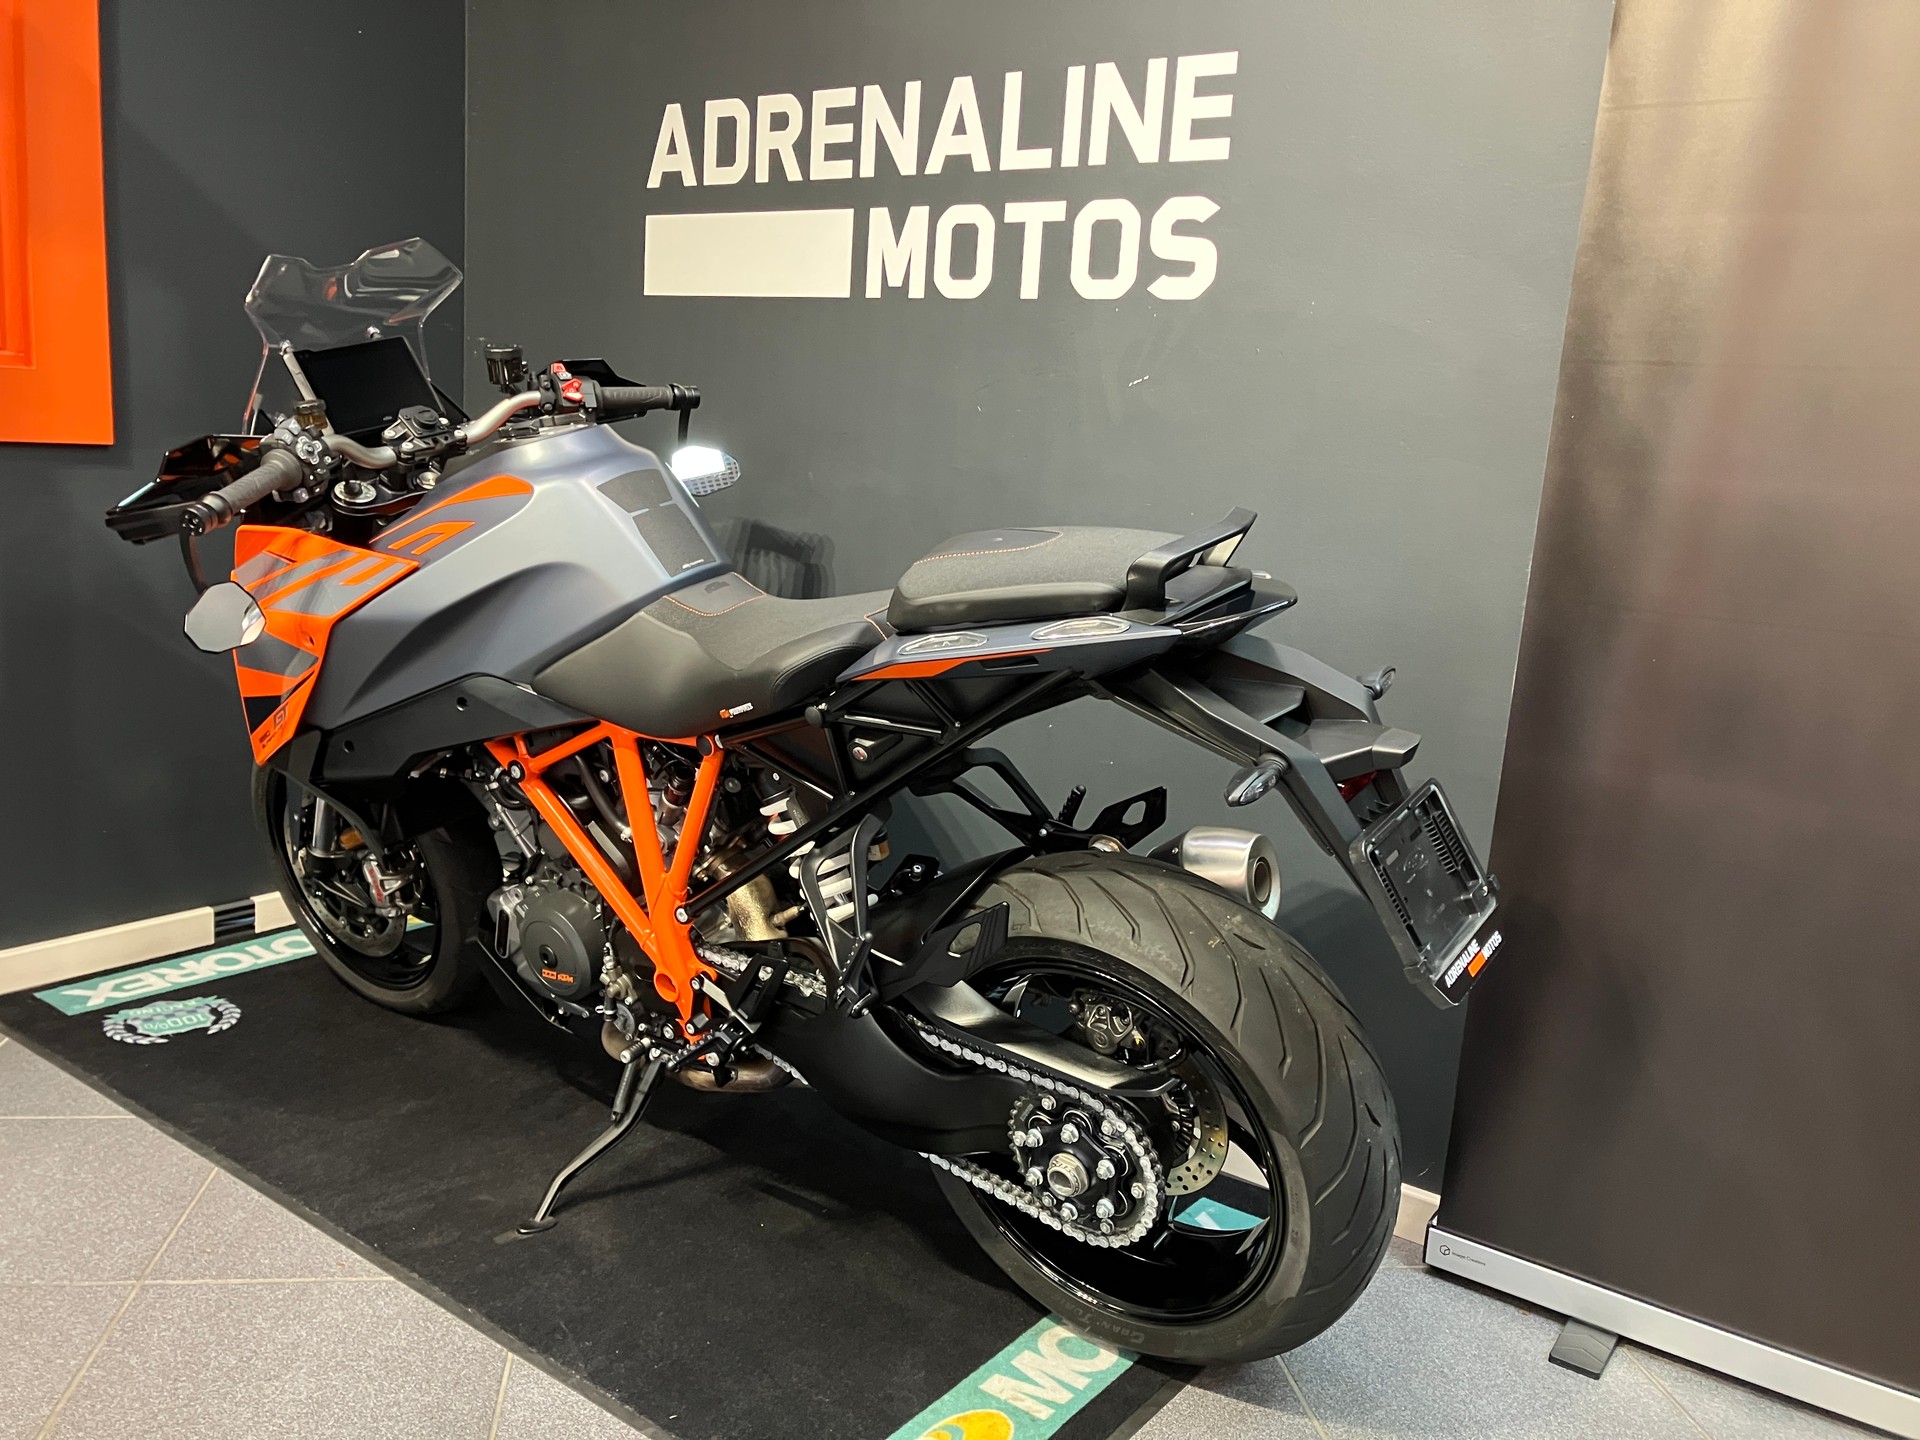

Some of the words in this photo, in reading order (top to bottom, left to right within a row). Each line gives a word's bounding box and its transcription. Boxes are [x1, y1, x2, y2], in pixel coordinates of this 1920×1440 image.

[646, 51, 1239, 187] ADRENALINE
[865, 196, 1221, 300] MOTOS
[61, 934, 315, 1007] OTOREX
[1444, 938, 1481, 989] ADRENALINE
[1480, 930, 1503, 961] MOTOS
[143, 1012, 209, 1031] 100%
[978, 1325, 1119, 1421] MO
